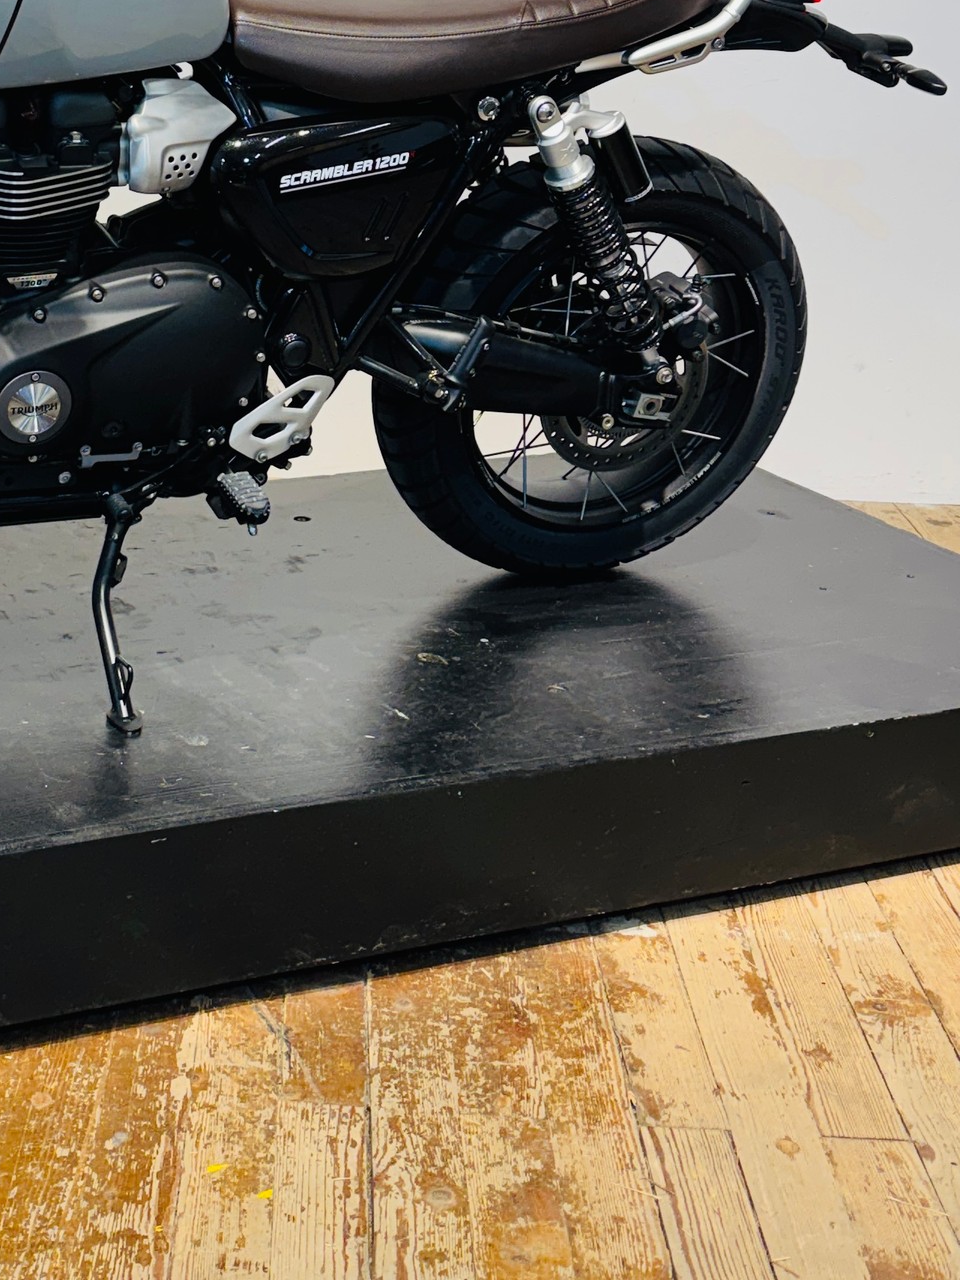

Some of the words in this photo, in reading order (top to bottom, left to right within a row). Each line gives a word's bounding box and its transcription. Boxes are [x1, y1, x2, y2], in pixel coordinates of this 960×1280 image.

[279, 159, 374, 189] SCRAMBLER
[374, 152, 410, 170] 1200
[10, 402, 58, 417] TRIUMPH
